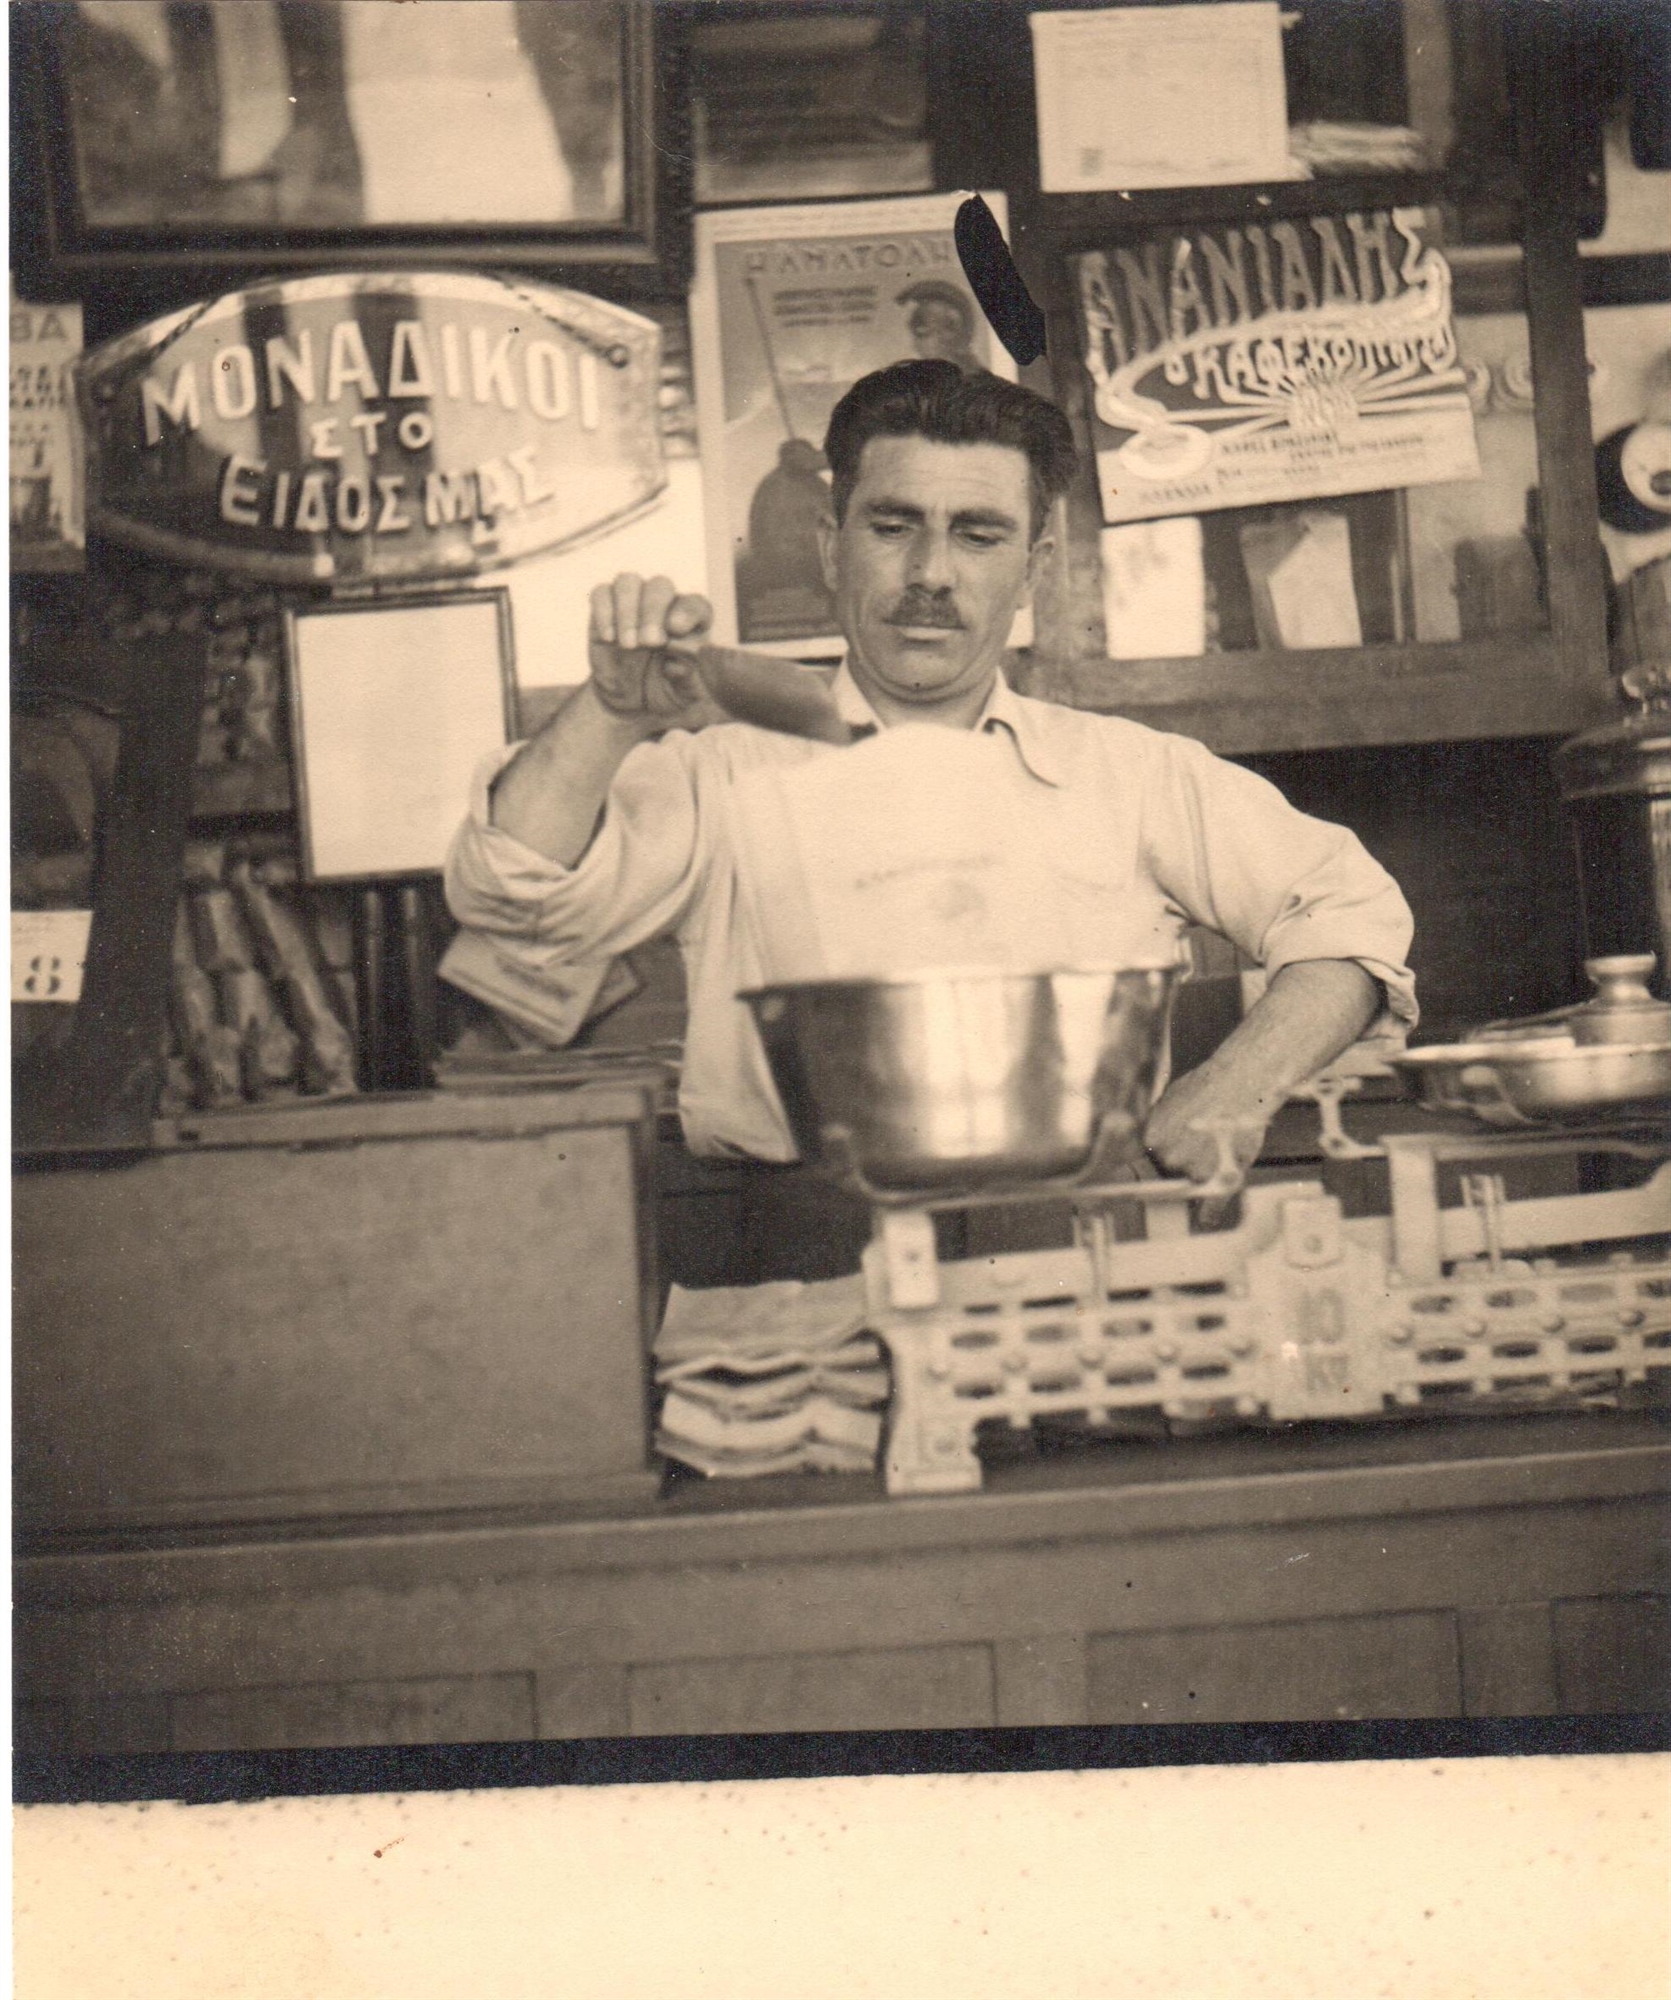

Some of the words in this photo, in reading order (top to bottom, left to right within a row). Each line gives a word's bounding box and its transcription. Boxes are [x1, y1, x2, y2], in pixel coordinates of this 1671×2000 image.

[140, 319, 600, 447] ΜΟΝΑΔΙΚΟΙ
[310, 411, 435, 459] ΣΤΟ
[220, 453, 411, 532] ΕΙΔΟΣ
[424, 445, 556, 530] ΜΑΣ
